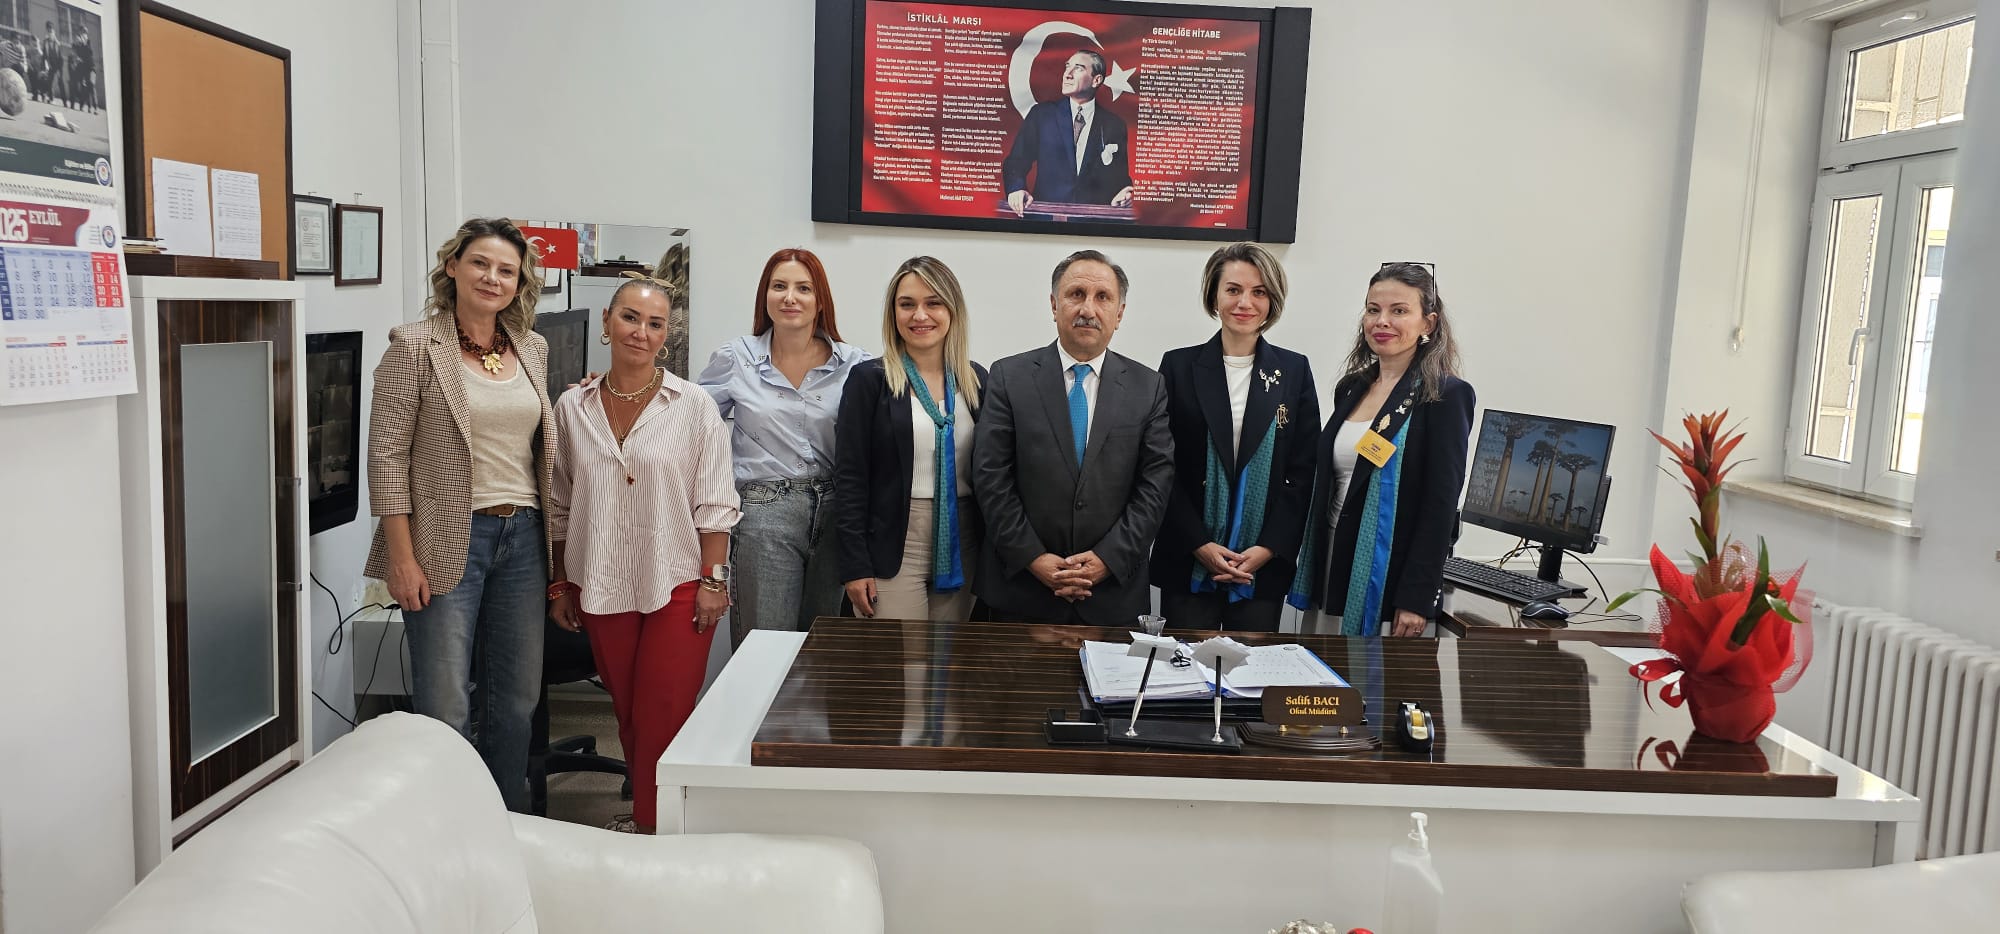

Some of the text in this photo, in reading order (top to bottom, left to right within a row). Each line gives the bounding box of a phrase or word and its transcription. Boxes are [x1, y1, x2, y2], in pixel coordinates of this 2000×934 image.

[907, 12, 982, 26] İSTİKLÂL MARŞI
[1152, 27, 1221, 38] GENÇLİĞE HİTABE
[29, 209, 62, 226] EYLÜL
[96, 262, 102, 271] 6
[110, 275, 118, 283] 14
[1286, 695, 1340, 706] Salih BACI
[1290, 707, 1337, 715] Okul Müdürü
